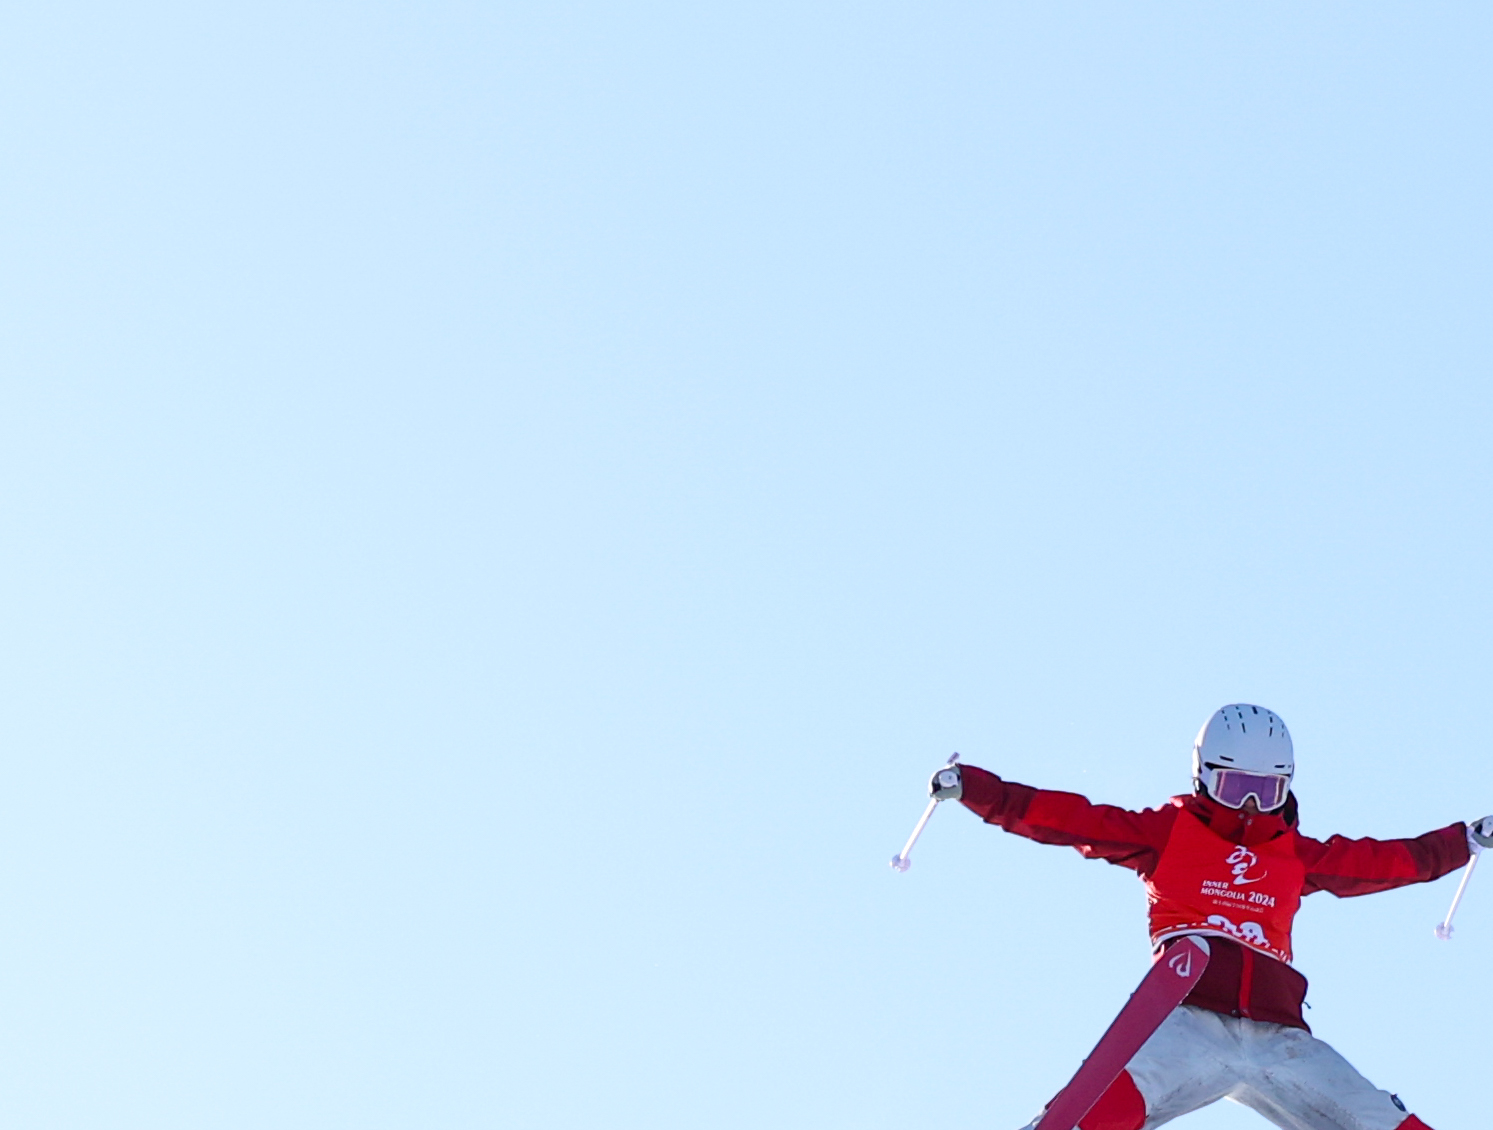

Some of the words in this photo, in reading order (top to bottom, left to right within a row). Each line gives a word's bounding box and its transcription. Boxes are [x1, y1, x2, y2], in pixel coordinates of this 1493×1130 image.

[1203, 880, 1229, 890] INNER
[1201, 888, 1245, 901] MONGOLIA
[1248, 891, 1276, 908] 2024
